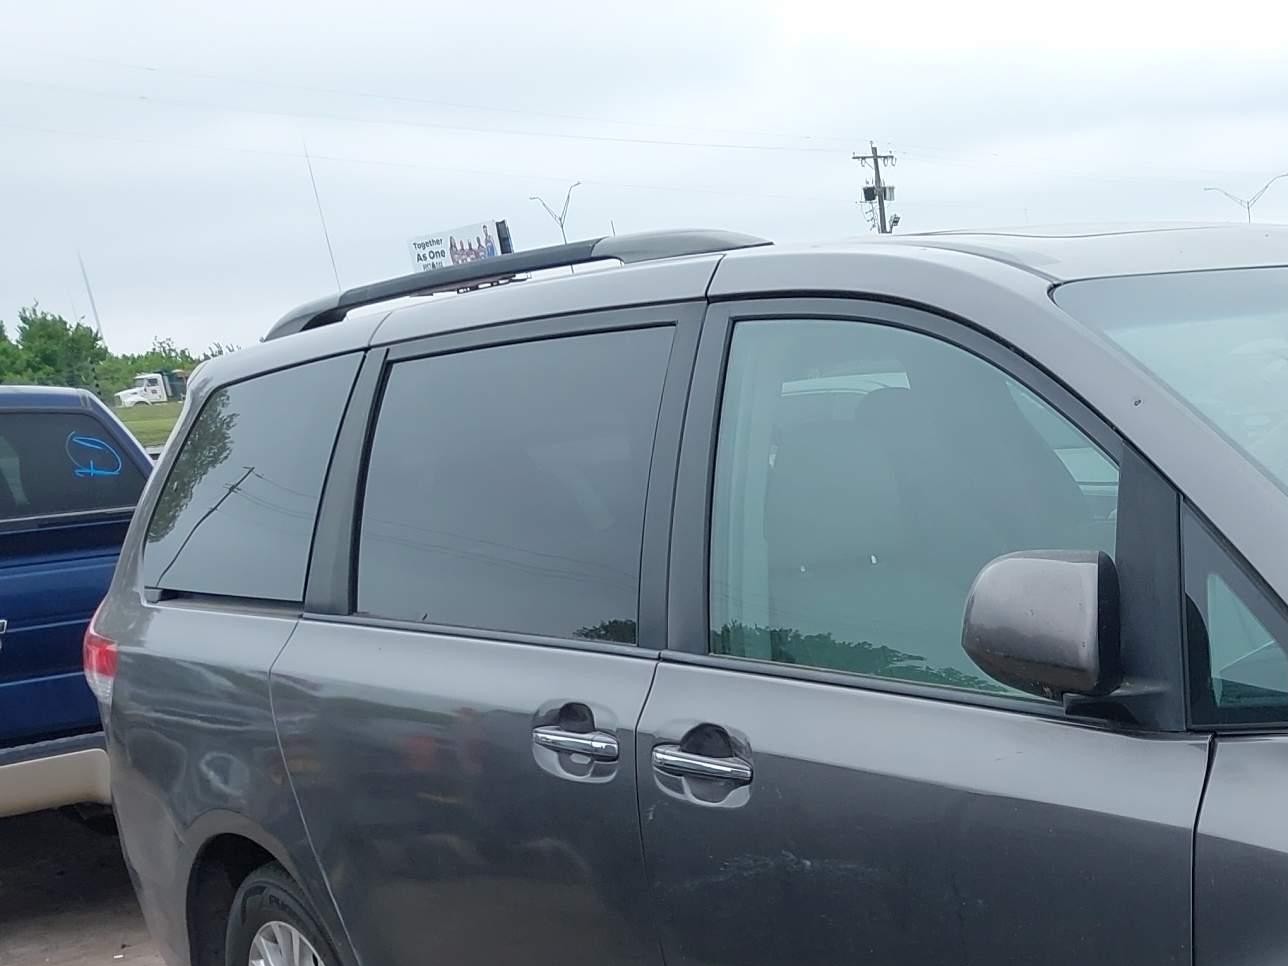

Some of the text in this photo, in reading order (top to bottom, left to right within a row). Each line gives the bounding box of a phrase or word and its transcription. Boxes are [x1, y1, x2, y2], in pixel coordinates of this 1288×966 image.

[413, 238, 443, 250] Together
[416, 249, 446, 263] As One
